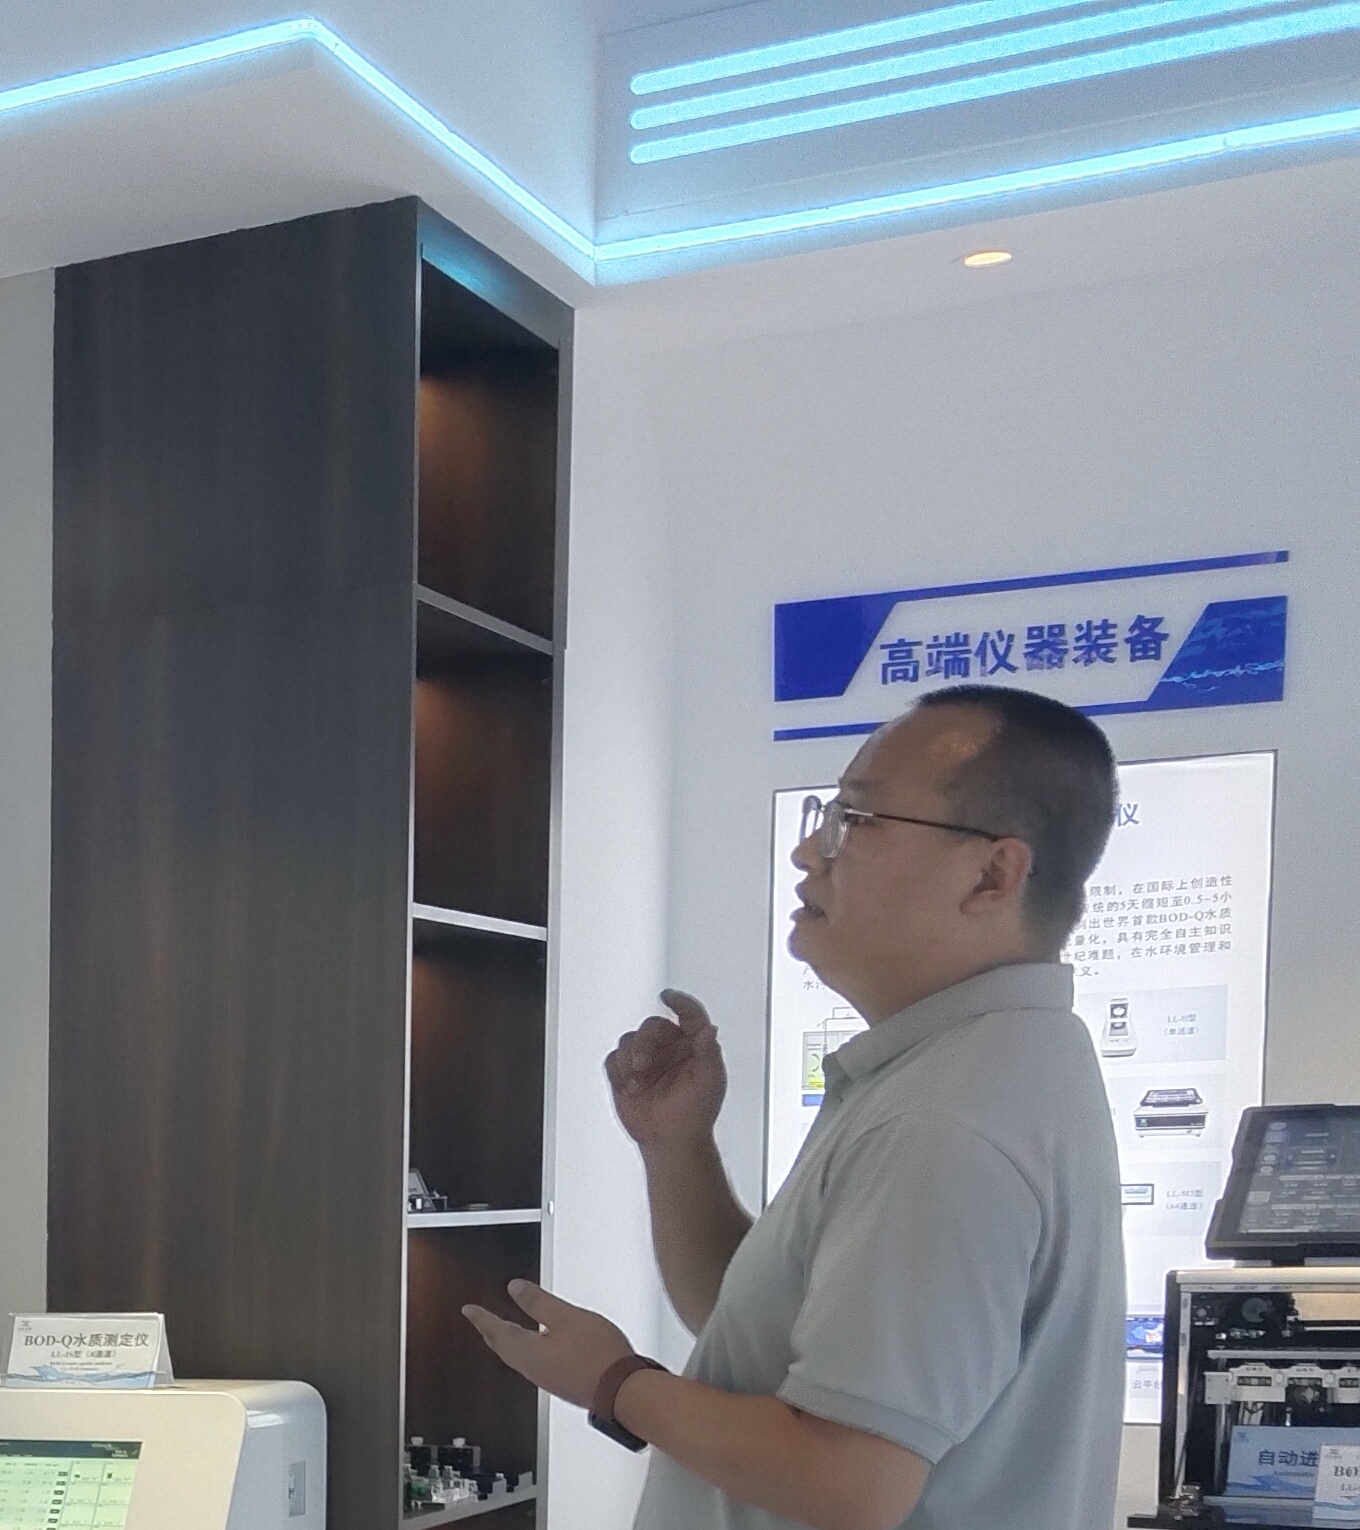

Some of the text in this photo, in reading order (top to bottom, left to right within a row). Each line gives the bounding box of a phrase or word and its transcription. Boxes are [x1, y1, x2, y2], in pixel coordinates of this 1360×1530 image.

[879, 614, 1171, 685] 高端仪器装备
[1084, 891, 1232, 913] 统的5天缩短至0.5~5小
[24, 1332, 149, 1348] BOD-Q水质测定仪
[1258, 1450, 1318, 1467] 自动进
